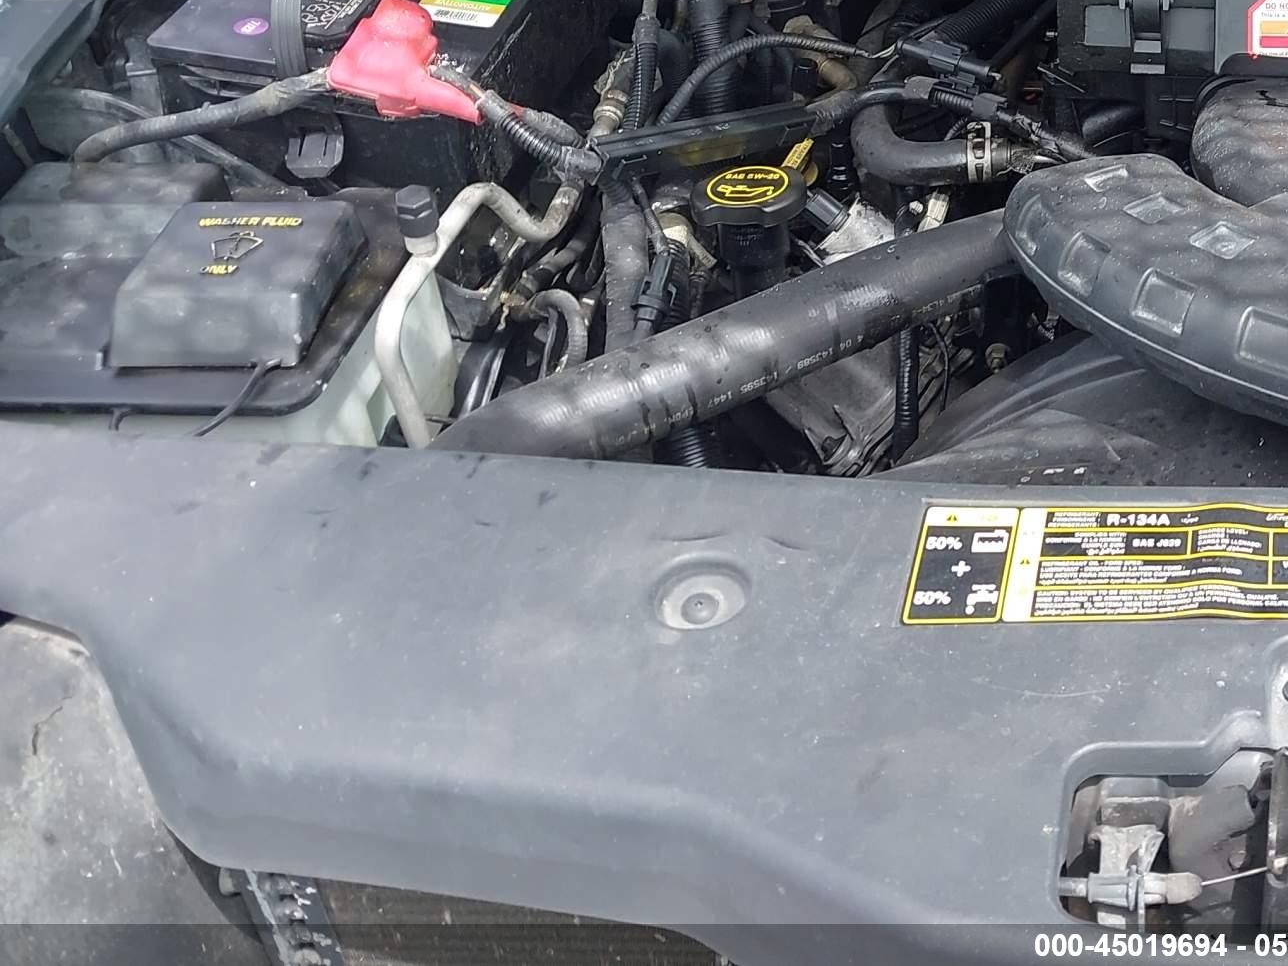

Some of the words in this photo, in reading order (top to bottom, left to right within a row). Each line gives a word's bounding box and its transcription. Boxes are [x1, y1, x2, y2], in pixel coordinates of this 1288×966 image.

[199, 217, 261, 227] WASHER
[261, 216, 304, 227] FLUID
[199, 265, 240, 275] ONLY
[1107, 514, 1171, 526] R-134A
[925, 536, 963, 550] 50%
[1132, 538, 1155, 547] SAE
[913, 590, 952, 606] 50%
